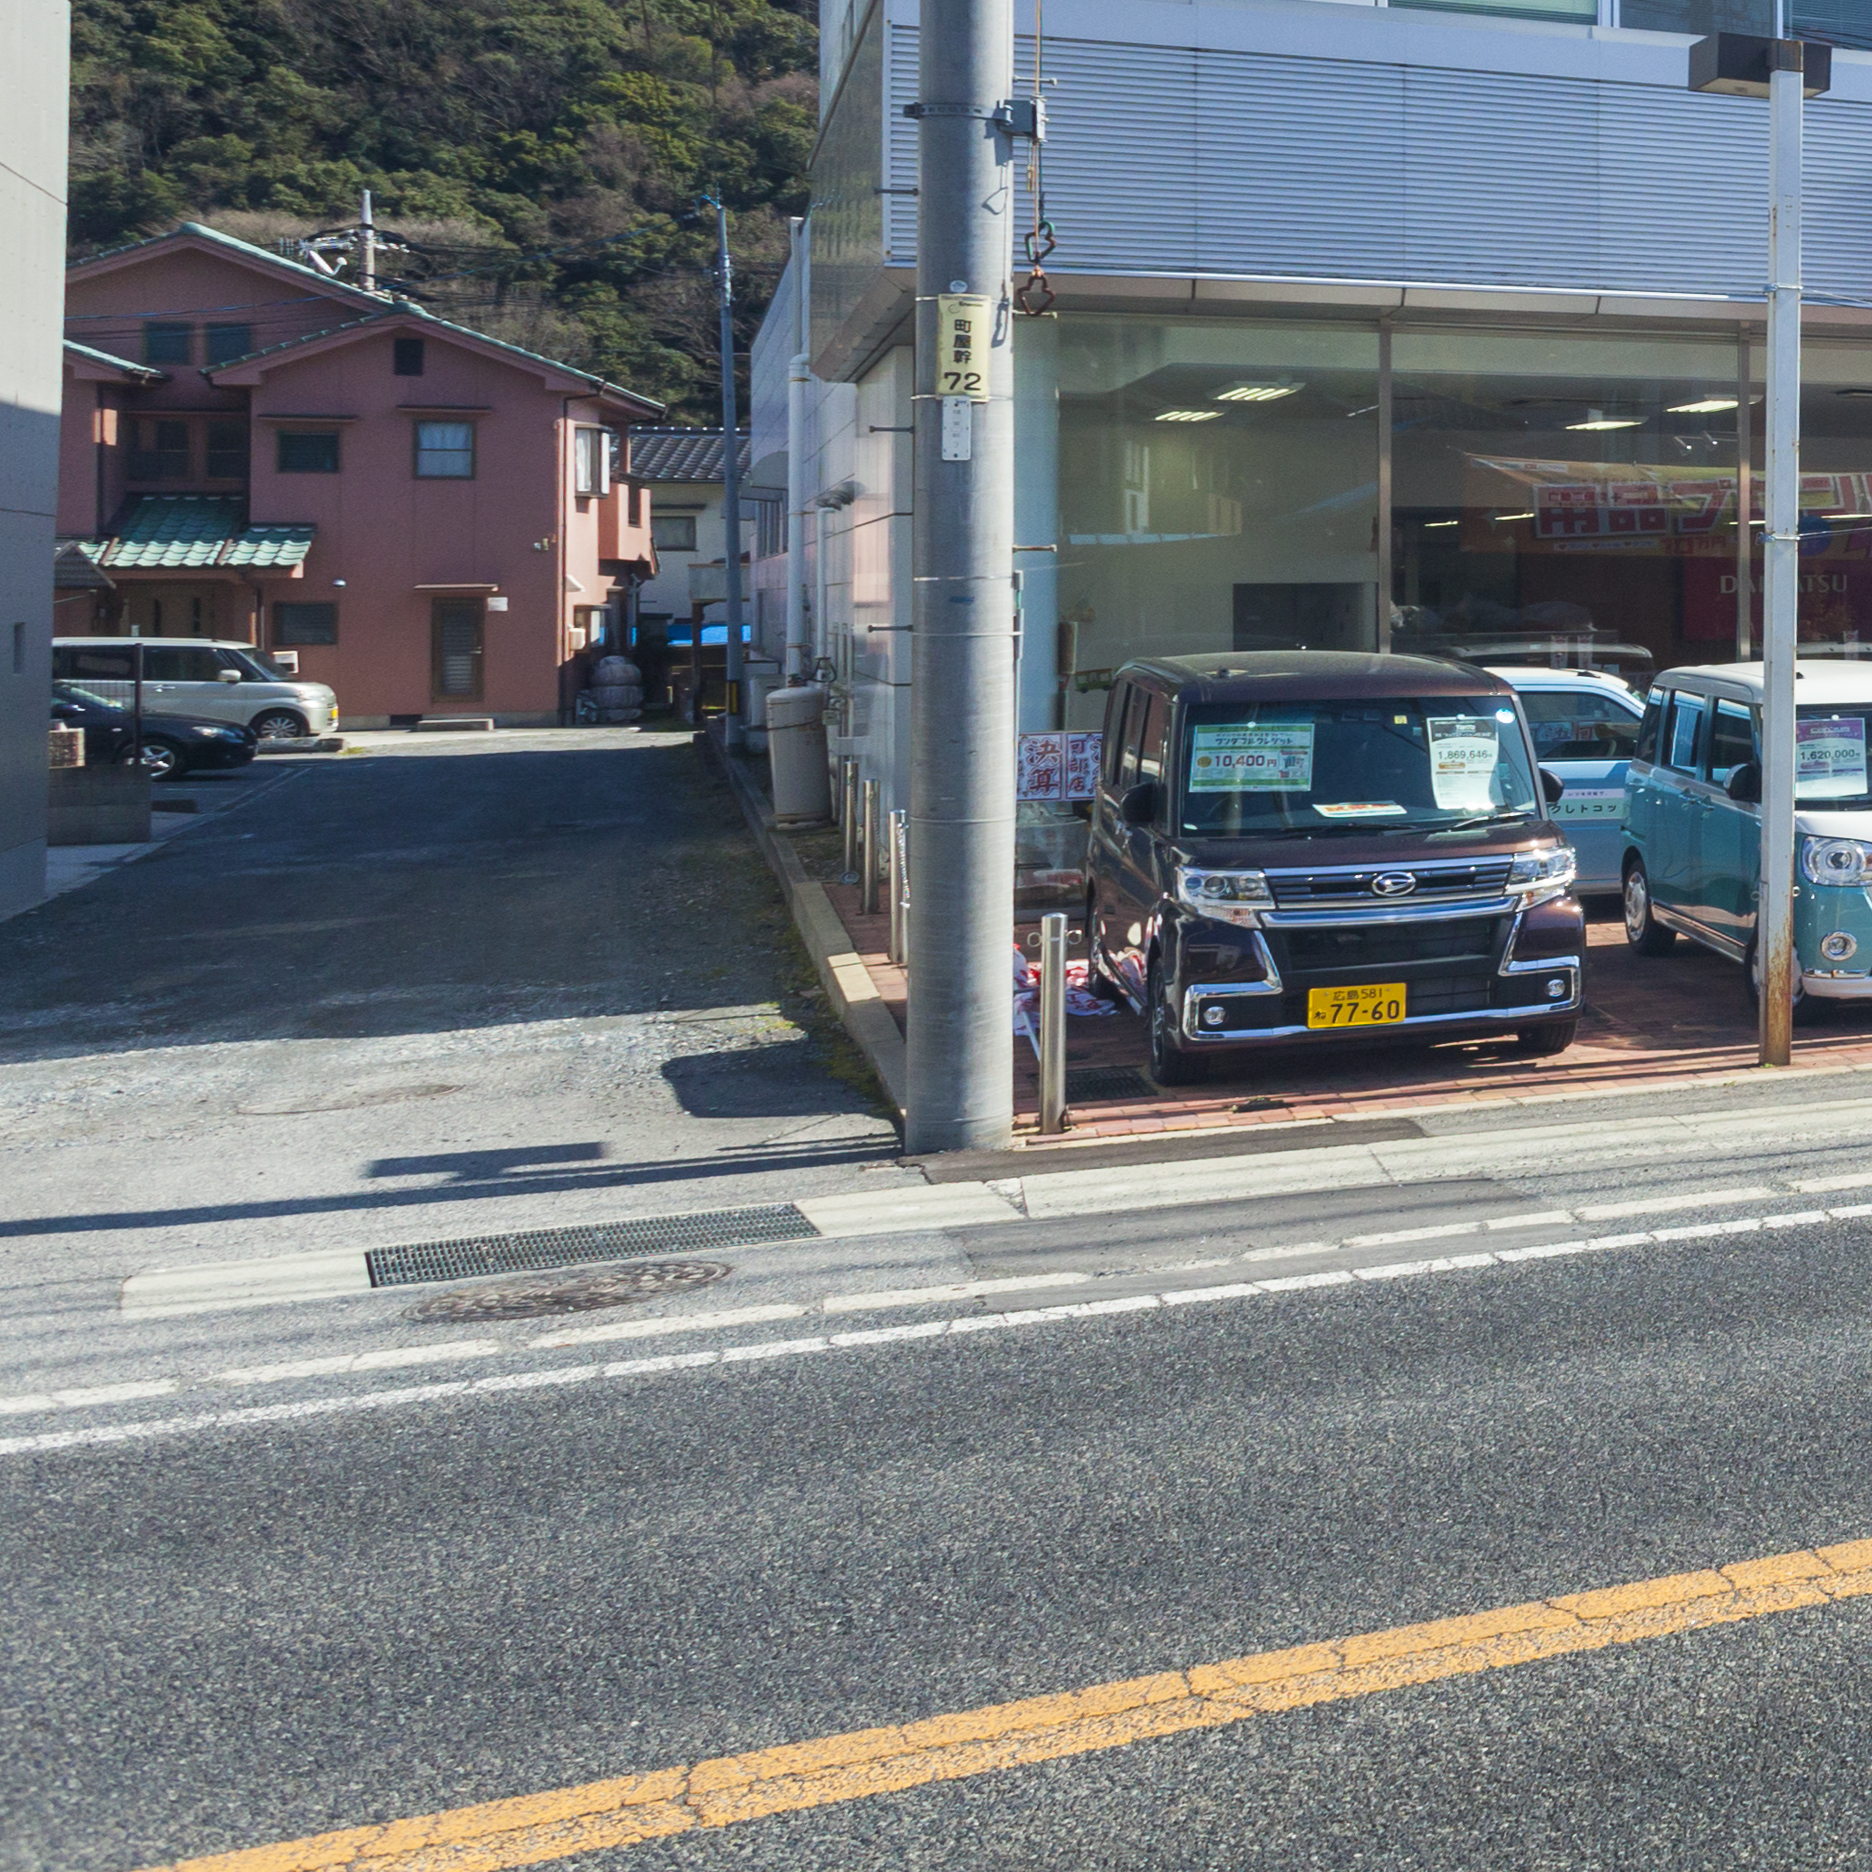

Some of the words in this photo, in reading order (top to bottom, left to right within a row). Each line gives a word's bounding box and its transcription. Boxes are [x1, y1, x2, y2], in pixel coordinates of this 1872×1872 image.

[943, 371, 982, 391] 72
[1214, 754, 1277, 768] 10,400円
[1333, 990, 1360, 1001] 広島
[1360, 988, 1383, 1000] 581
[1330, 1000, 1400, 1024] 77-60
